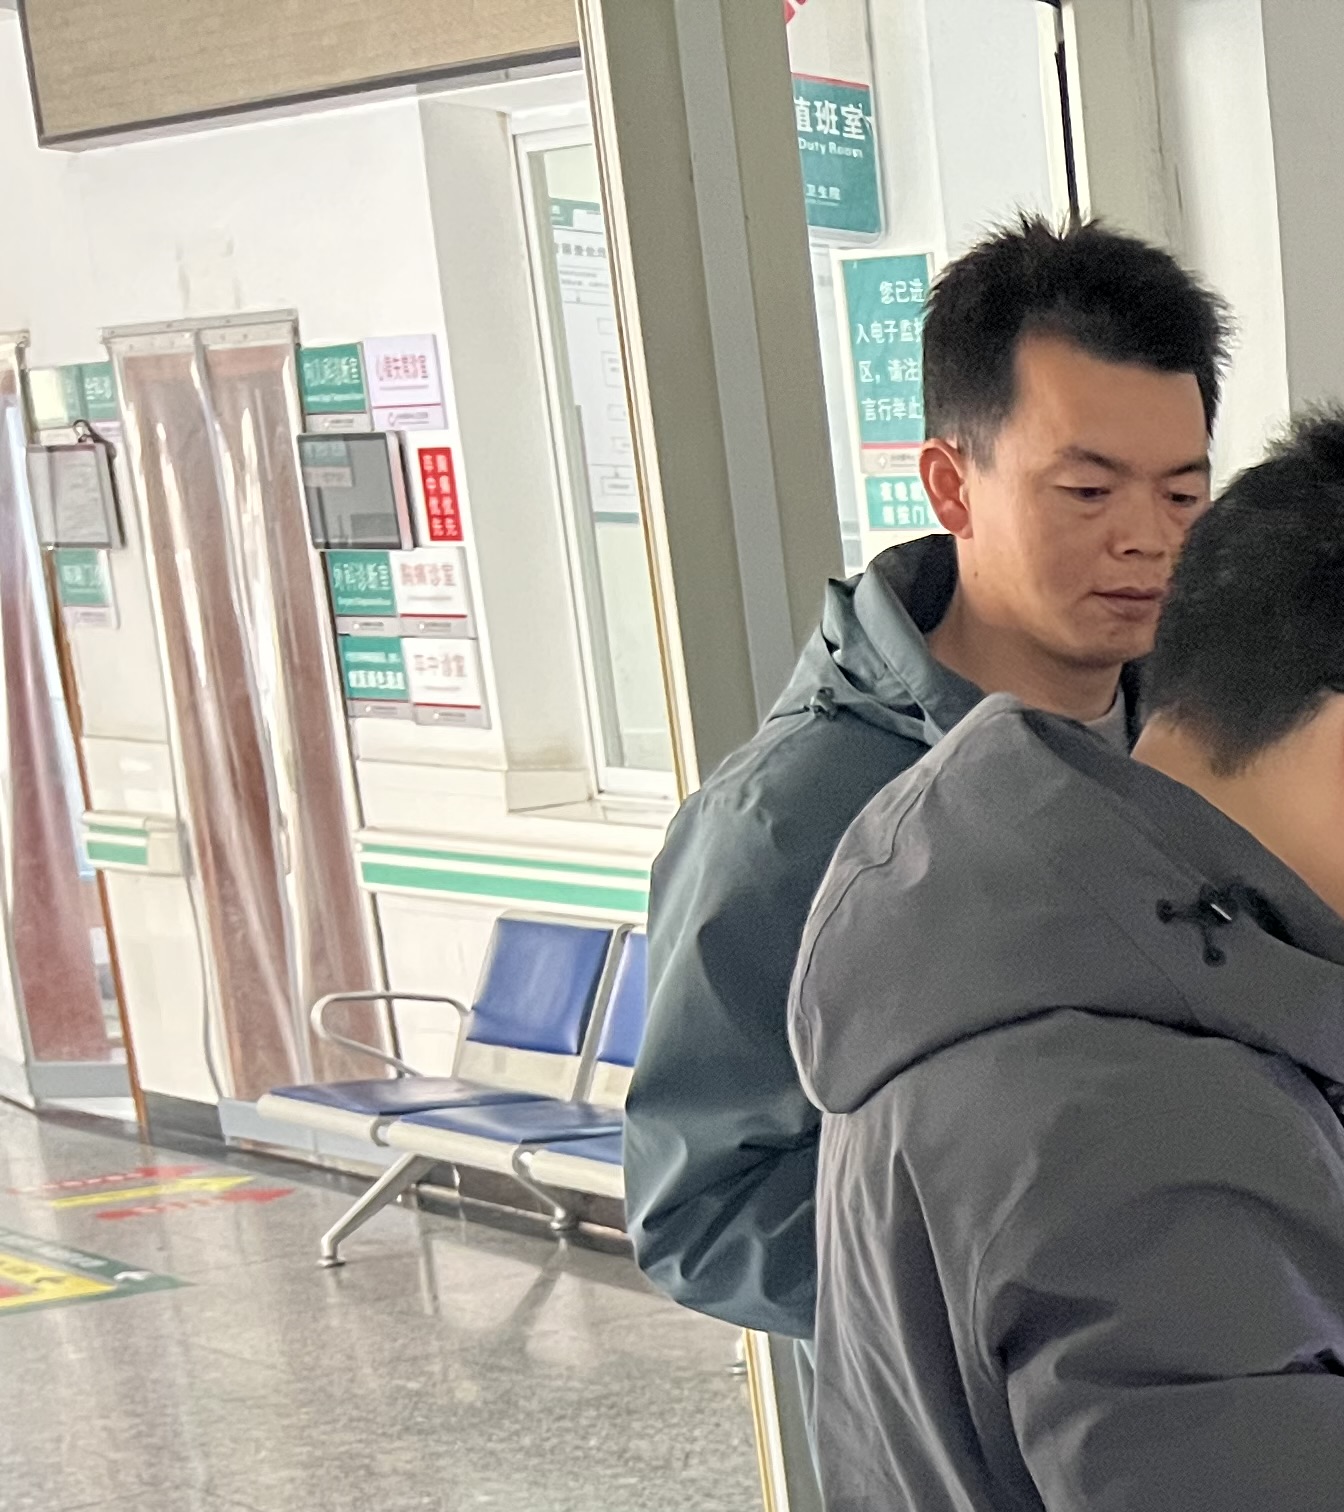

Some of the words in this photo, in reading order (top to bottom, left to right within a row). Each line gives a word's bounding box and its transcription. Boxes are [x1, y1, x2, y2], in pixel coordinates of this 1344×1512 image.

[793, 96, 866, 141] 值班室
[798, 136, 826, 156] Duty
